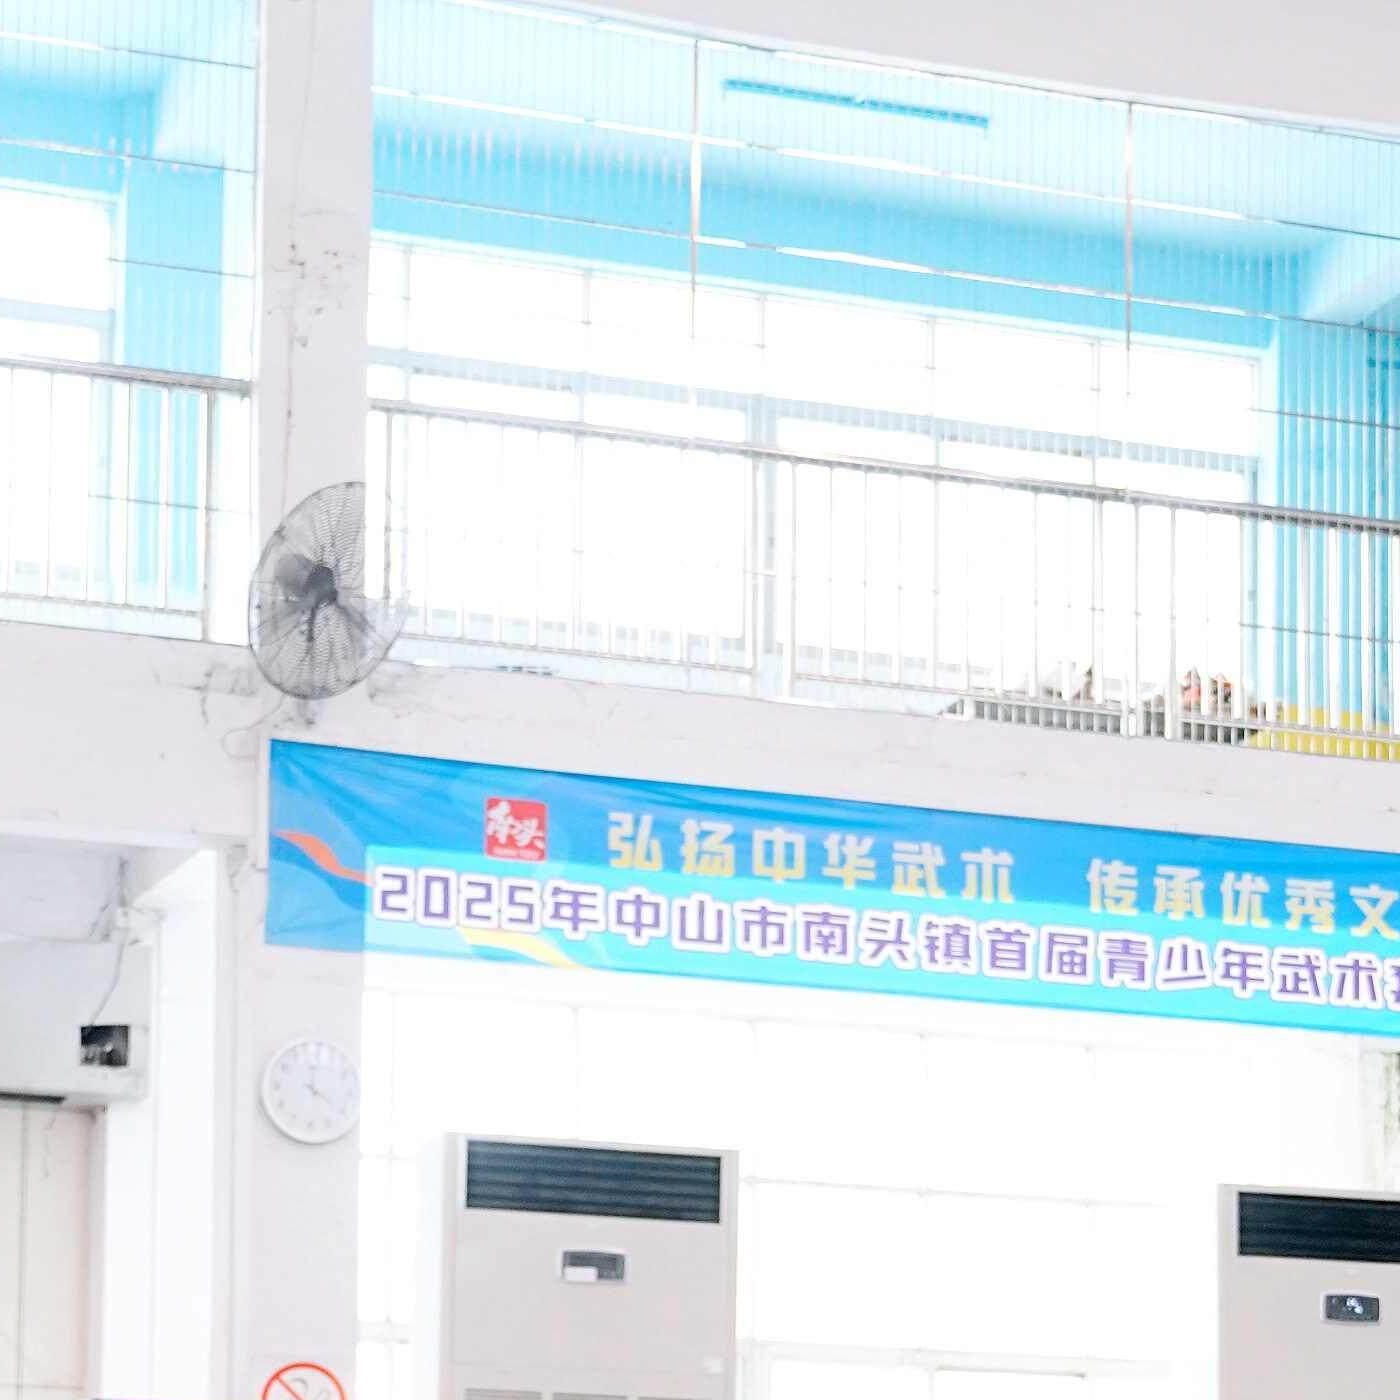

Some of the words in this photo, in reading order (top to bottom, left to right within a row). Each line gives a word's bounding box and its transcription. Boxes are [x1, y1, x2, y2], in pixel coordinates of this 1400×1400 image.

[607, 811, 1016, 903] 弘扬中华武术
